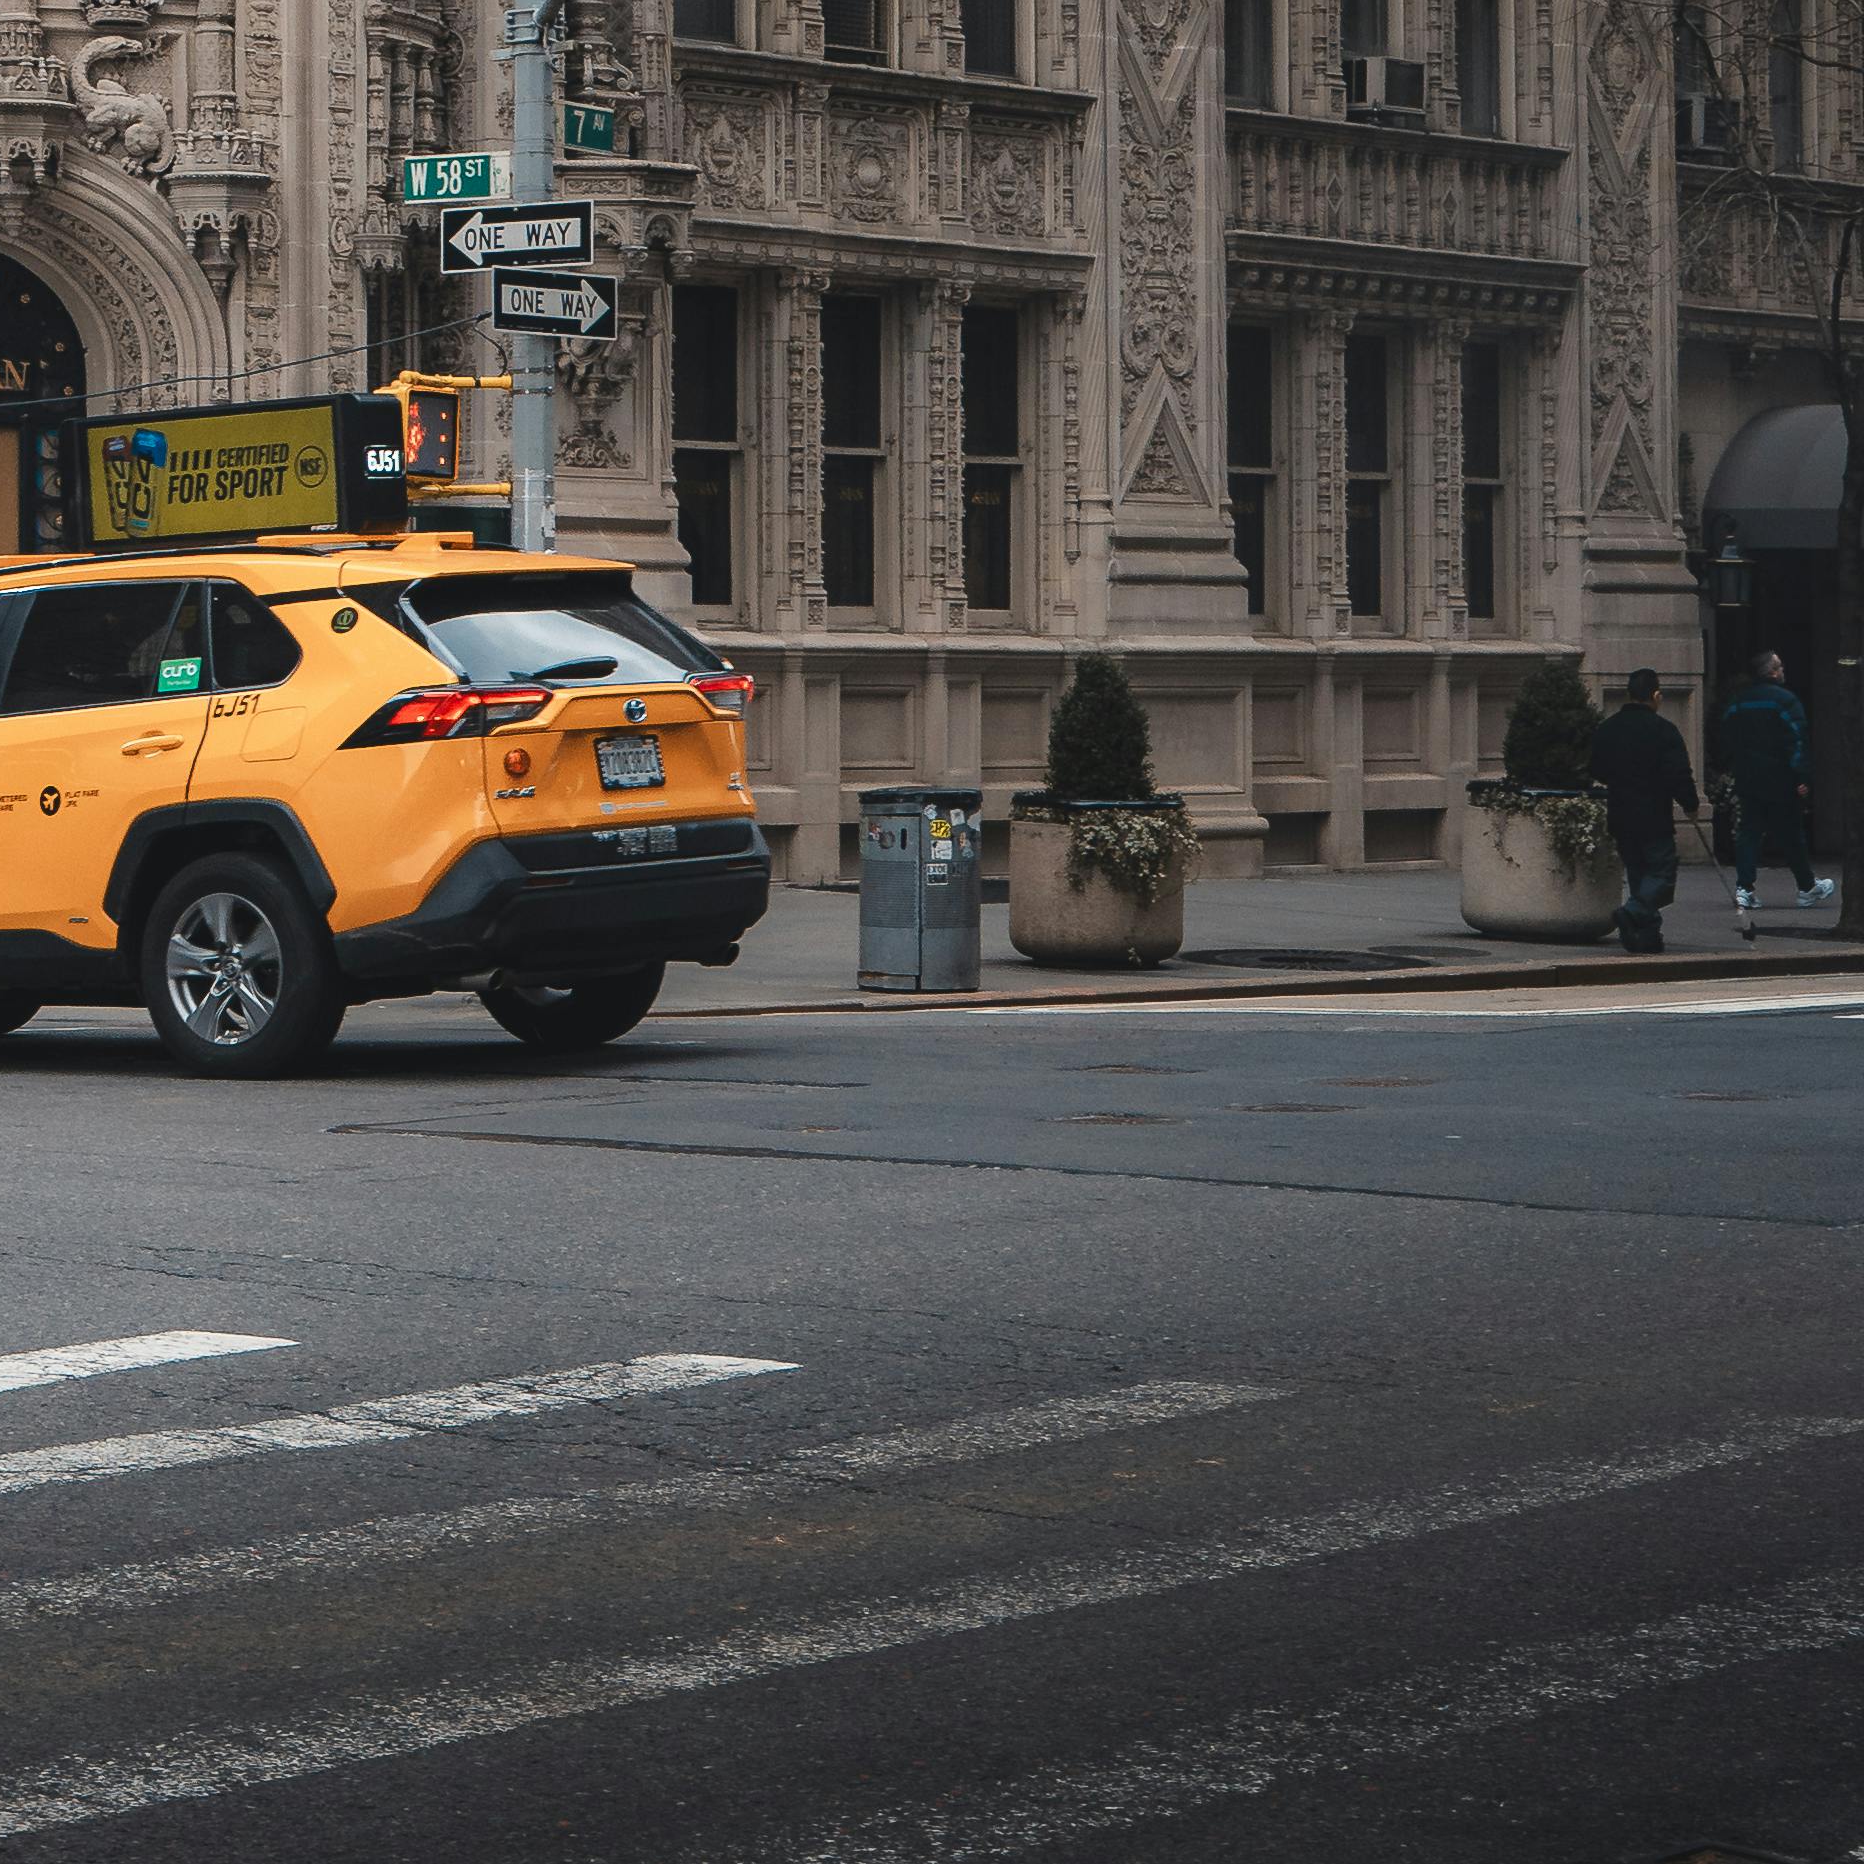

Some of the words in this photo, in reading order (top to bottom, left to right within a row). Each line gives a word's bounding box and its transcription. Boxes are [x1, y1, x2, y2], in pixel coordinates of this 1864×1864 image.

[573, 110, 585, 143] 7
[592, 113, 605, 131] AV
[410, 162, 428, 196] W
[436, 159, 462, 196] 58
[465, 158, 485, 178] ST
[464, 225, 505, 251] ONE
[526, 221, 572, 247] WAY
[511, 288, 545, 314] ONE
[560, 292, 598, 319] WAY
[217, 442, 290, 469] CERTIFIED
[367, 449, 400, 472] 6J51
[168, 472, 209, 504] FOR
[214, 465, 289, 501] SPORT
[213, 693, 261, 718] 6J51
